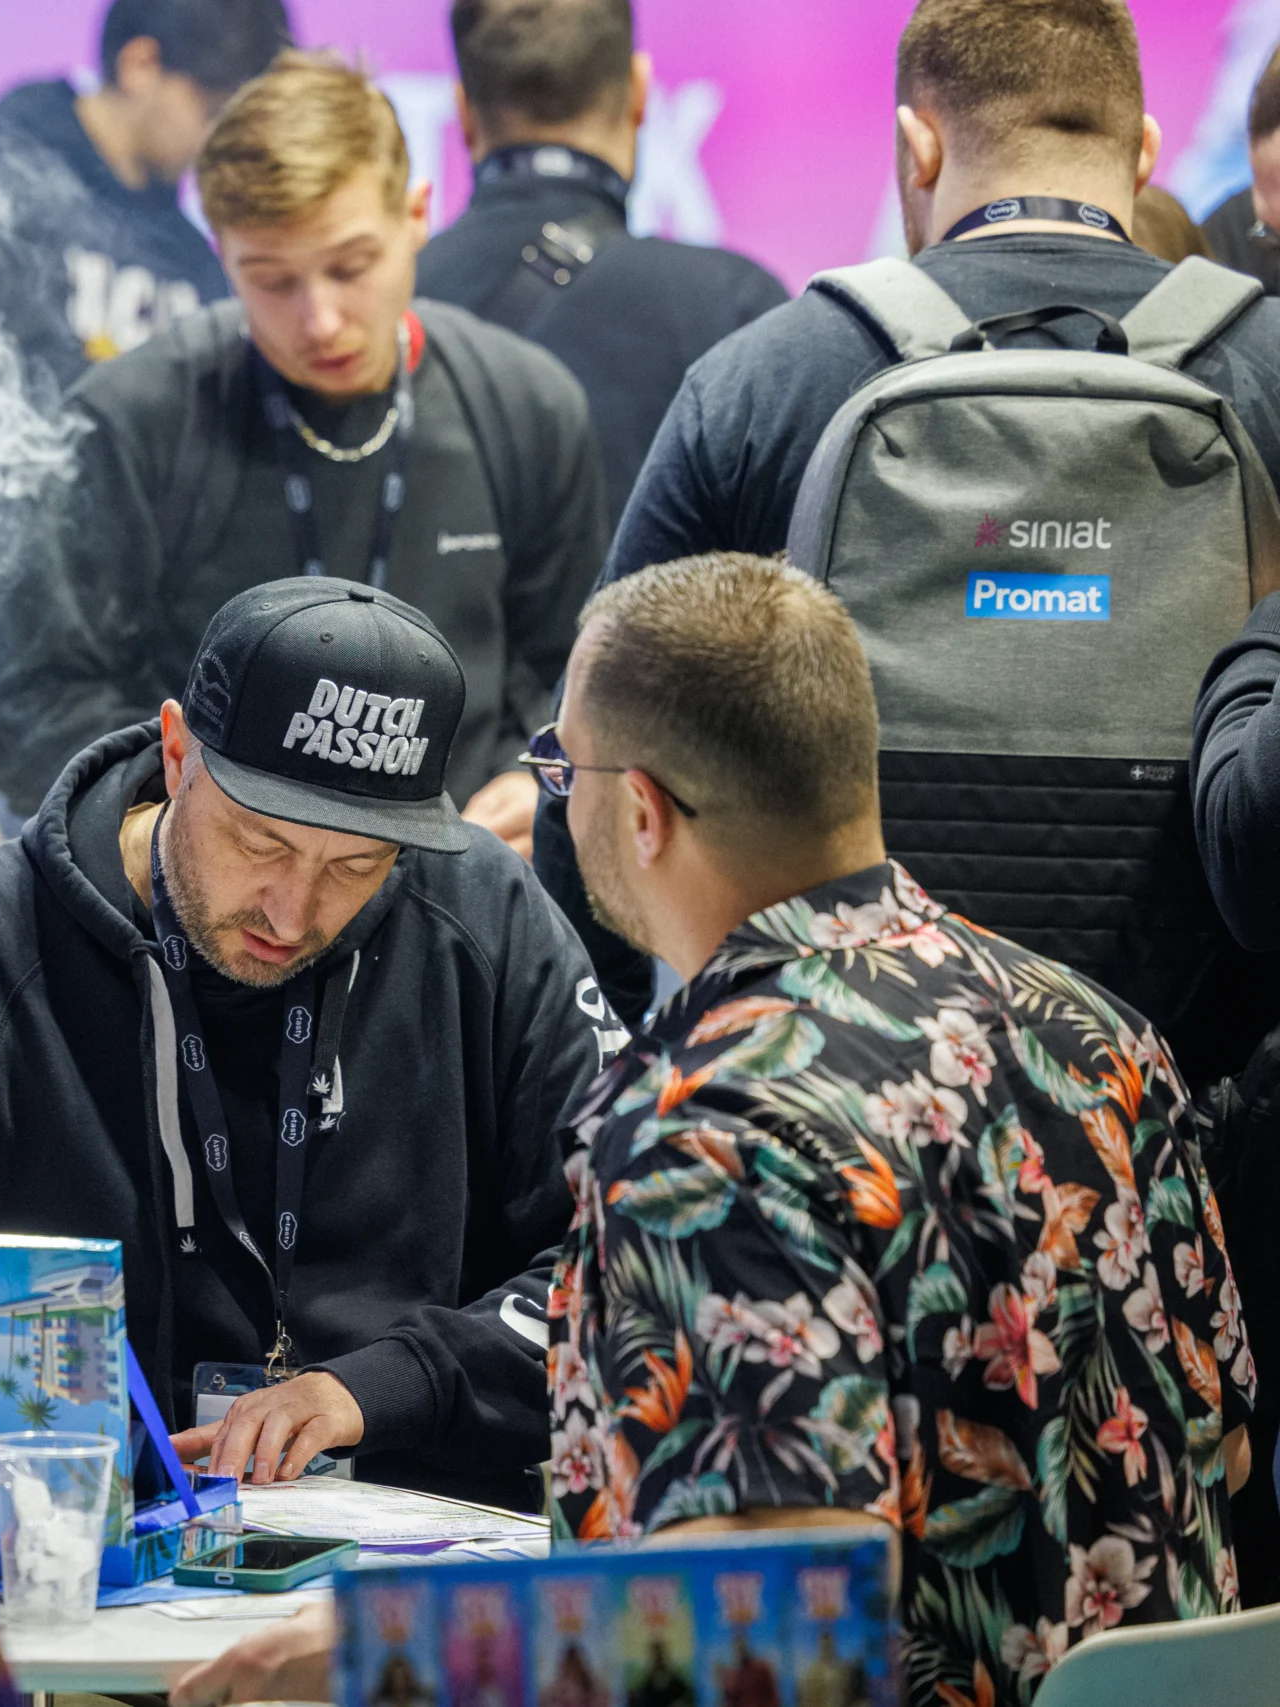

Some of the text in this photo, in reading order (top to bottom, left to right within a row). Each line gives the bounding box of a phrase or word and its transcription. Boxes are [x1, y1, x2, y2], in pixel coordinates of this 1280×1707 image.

[1008, 516, 1112, 550] siniat
[973, 578, 1103, 614] Promat
[306, 678, 426, 738] DUTCH
[282, 711, 431, 777] PASSION
[170, 939, 182, 968] e-tasty
[294, 1008, 304, 1040] e-tasty
[188, 1038, 200, 1069] e-tasty
[288, 1111, 298, 1142] e-tasty
[213, 1138, 222, 1168] e-tasty
[282, 1214, 291, 1246] e-tasty
